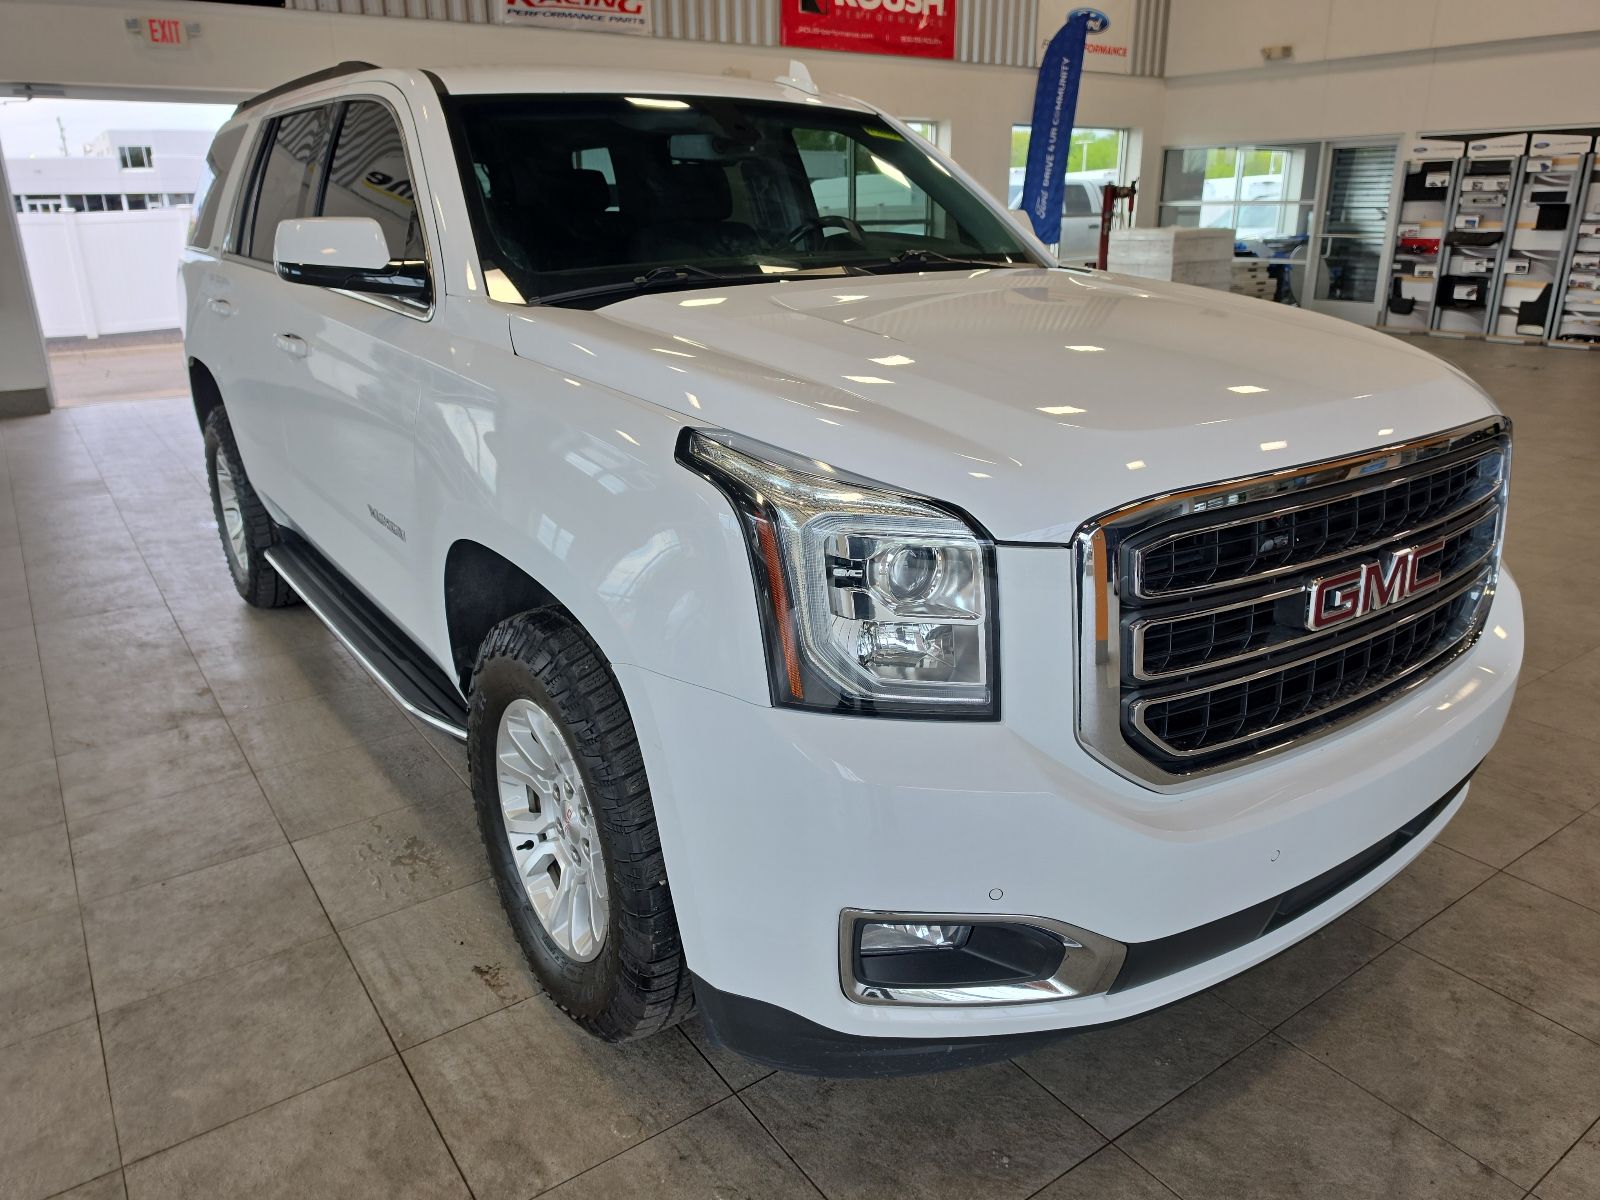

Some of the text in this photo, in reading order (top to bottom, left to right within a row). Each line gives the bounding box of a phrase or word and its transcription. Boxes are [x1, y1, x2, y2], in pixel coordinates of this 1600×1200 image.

[148, 18, 180, 43] EXIT
[507, 9, 605, 22] PERFORMANCE
[1052, 57, 1071, 126] COMMUNITY
[1049, 127, 1058, 144] UR
[1043, 153, 1055, 187] DRIVE
[1035, 190, 1049, 220] Ford
[1305, 536, 1446, 631] GMC
